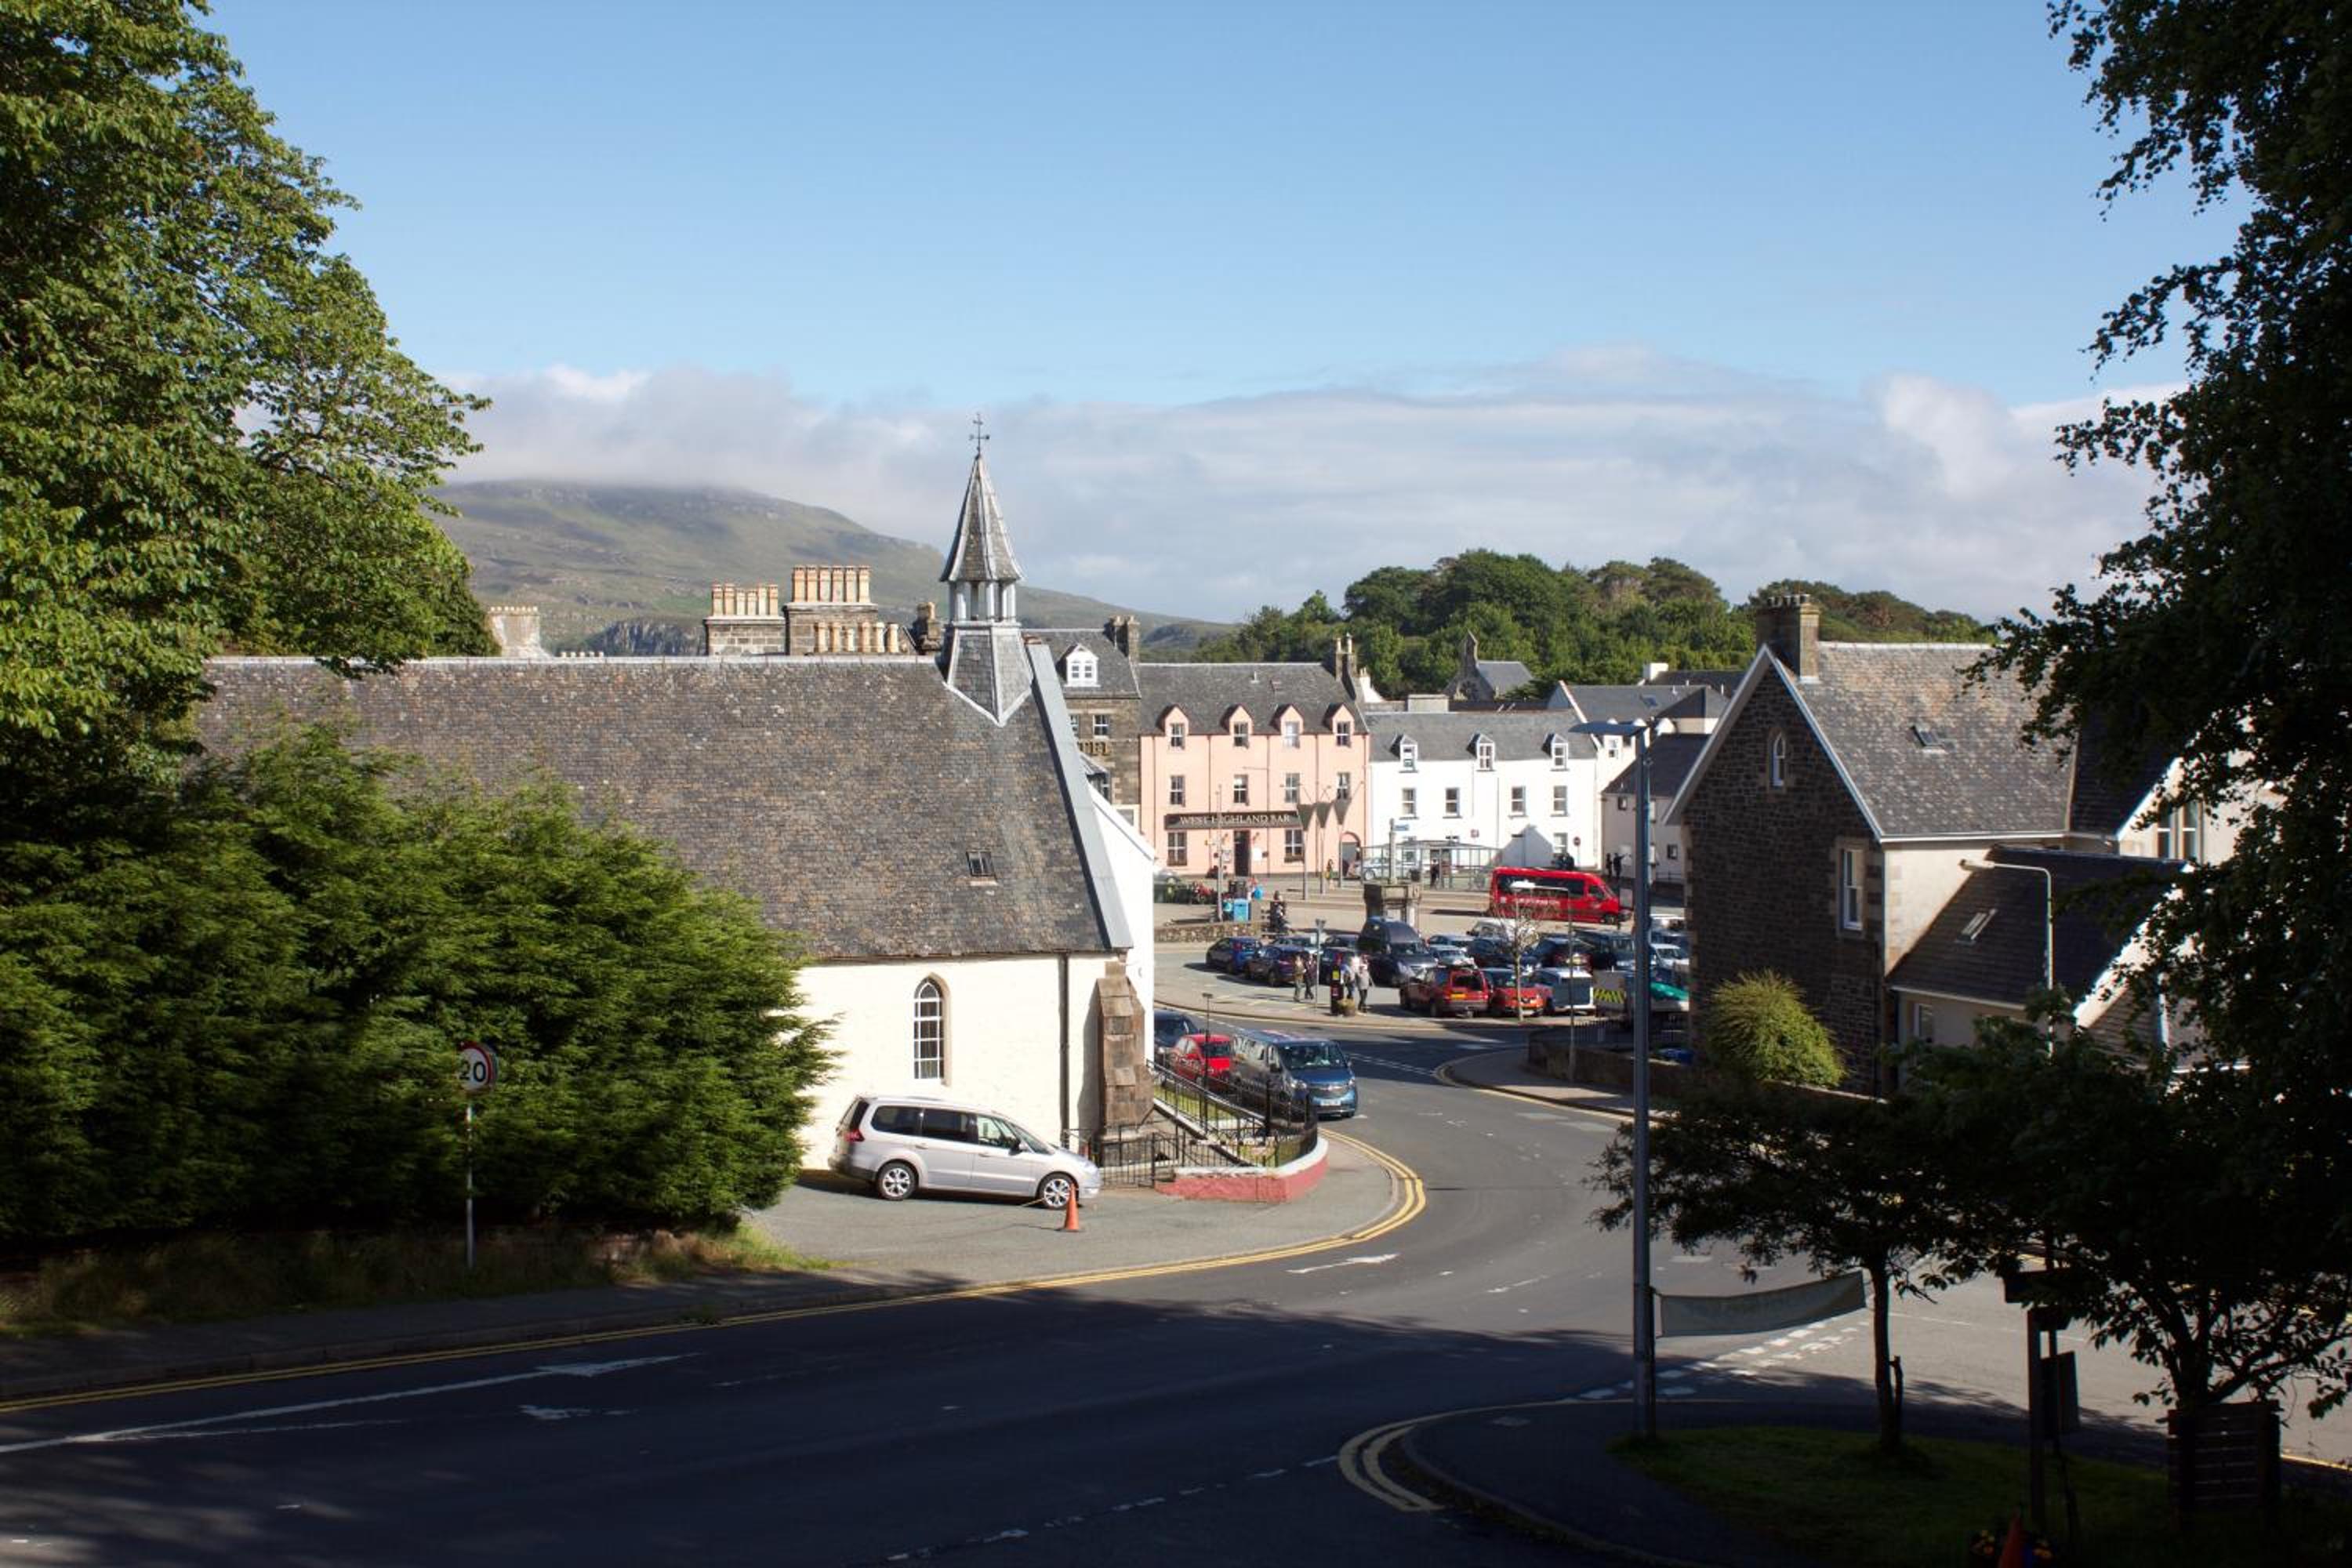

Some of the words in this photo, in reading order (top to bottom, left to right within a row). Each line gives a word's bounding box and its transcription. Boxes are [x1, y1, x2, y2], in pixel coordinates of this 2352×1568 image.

[1180, 815, 1209, 825] WEST
[1271, 815, 1290, 823] BAR
[460, 1061, 485, 1082] 20
